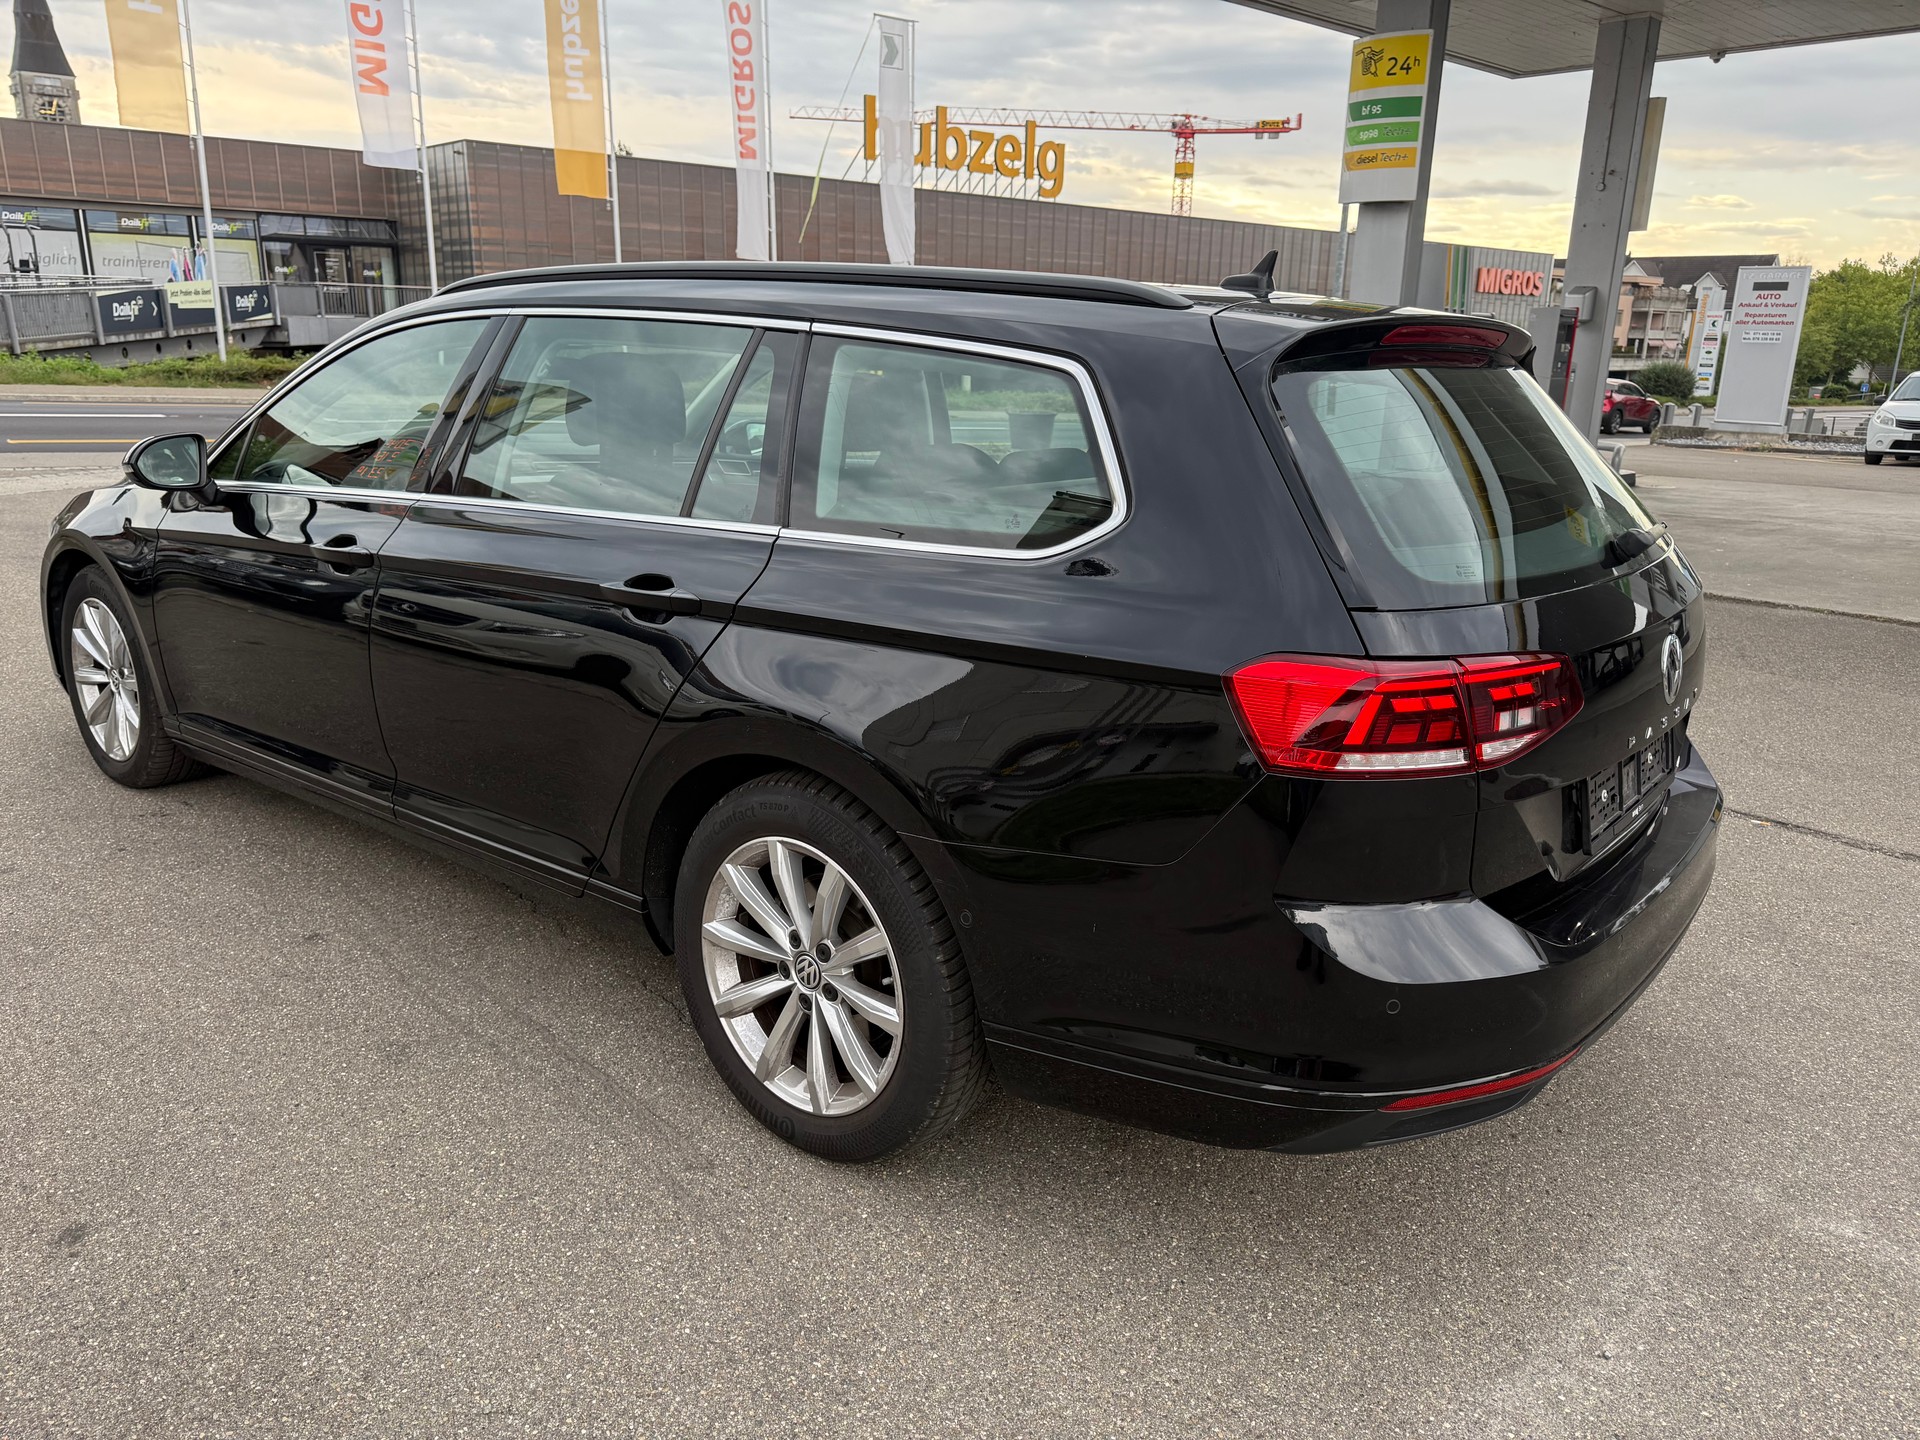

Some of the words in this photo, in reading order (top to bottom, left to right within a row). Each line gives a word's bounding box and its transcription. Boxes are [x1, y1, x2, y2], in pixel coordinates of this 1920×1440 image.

[1371, 104, 1382, 114] 95
[1356, 153, 1378, 165] diesel
[1380, 152, 1408, 162] Tech+
[102, 255, 170, 269] trainieren
[1476, 266, 1545, 297] MIGROS
